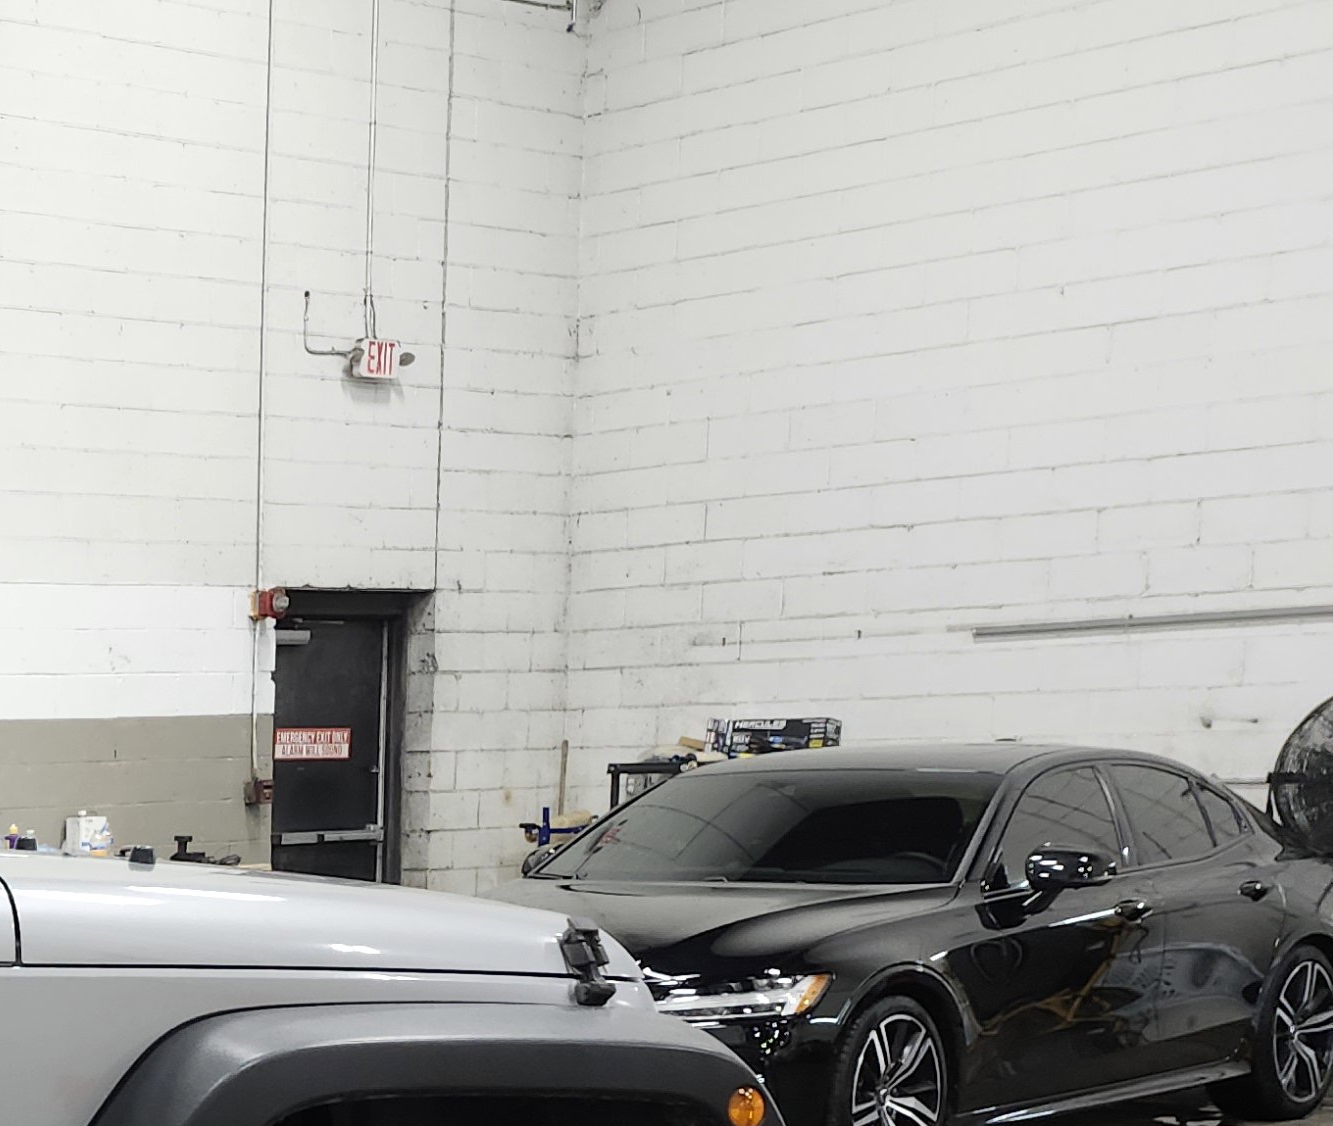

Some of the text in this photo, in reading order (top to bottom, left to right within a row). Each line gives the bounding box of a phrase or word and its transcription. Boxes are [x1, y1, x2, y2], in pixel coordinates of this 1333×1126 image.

[367, 341, 395, 375] EXIT
[276, 730, 315, 743] EMERGENCY
[316, 730, 331, 743] EXIT
